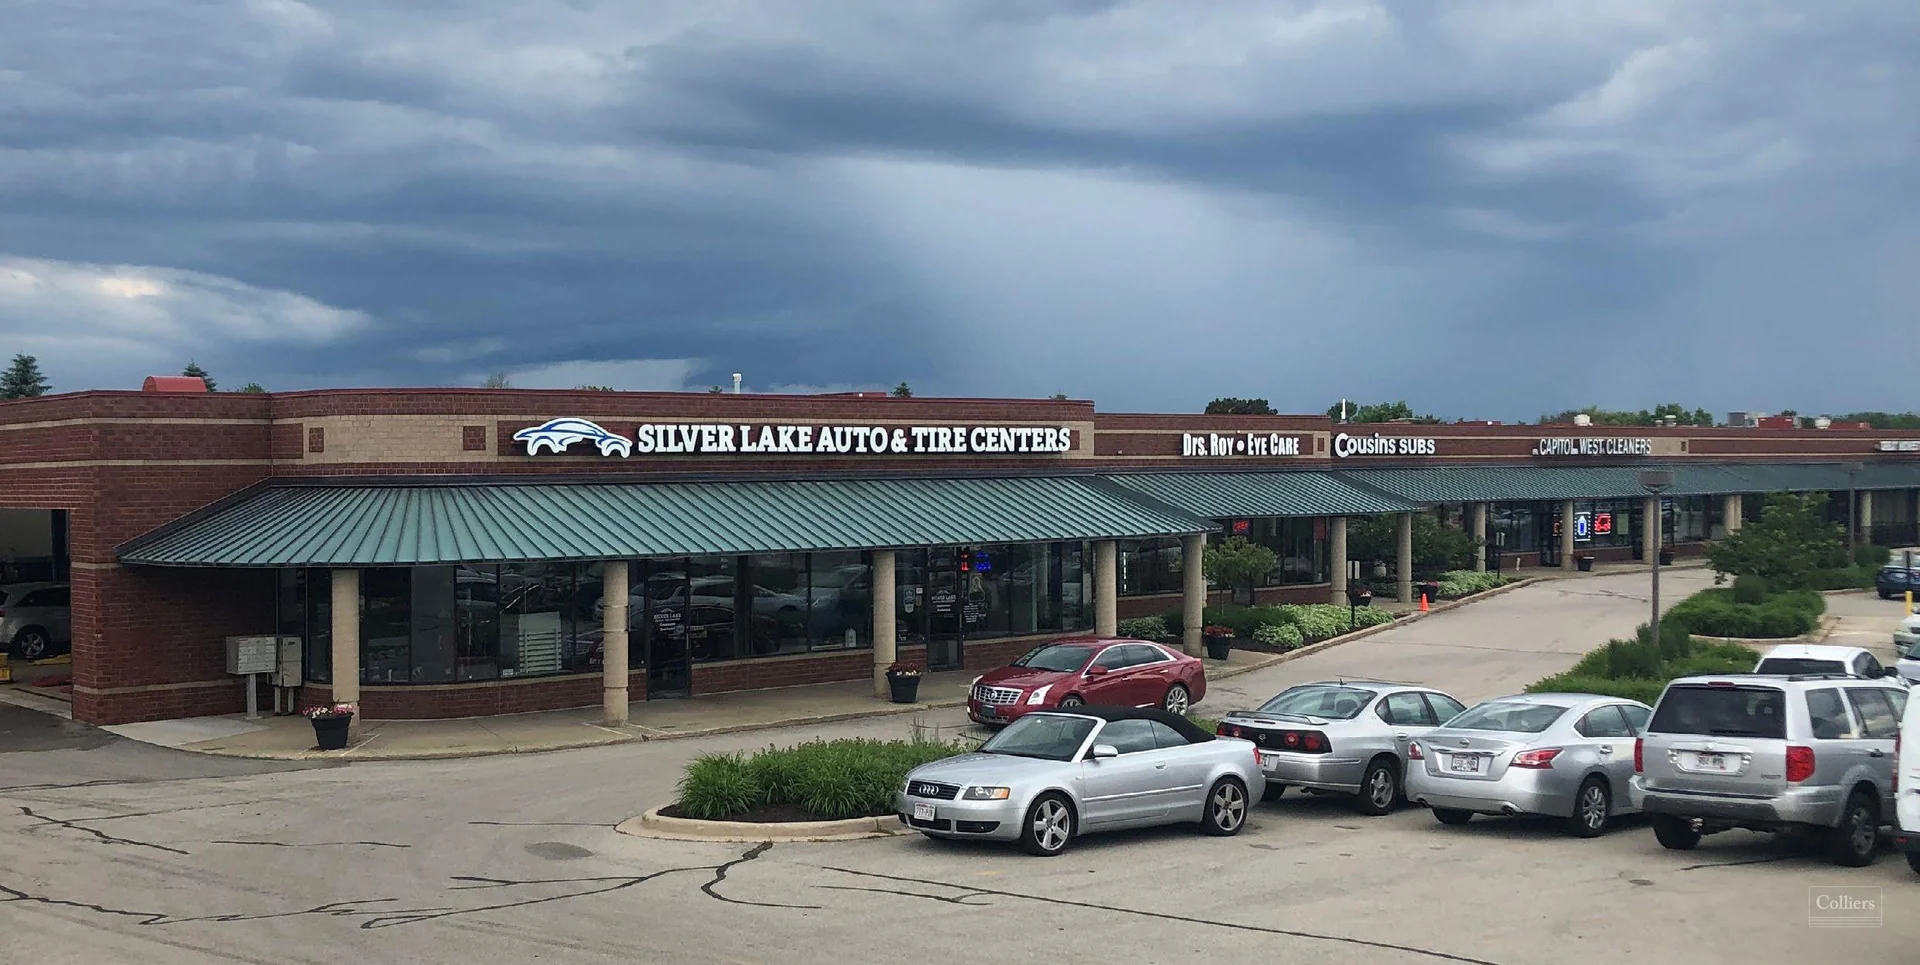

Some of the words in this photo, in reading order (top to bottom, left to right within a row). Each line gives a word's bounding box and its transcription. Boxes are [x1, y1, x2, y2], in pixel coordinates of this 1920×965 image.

[638, 424, 736, 453] SILVER
[740, 425, 813, 453] LAKE
[816, 426, 888, 453] AUTO
[890, 428, 908, 453] &
[911, 427, 967, 453] TIRE
[970, 427, 1071, 453] CENTERS
[1210, 433, 1234, 456] ROY
[1247, 433, 1268, 455] EYE
[1270, 433, 1299, 455] CARE
[1334, 432, 1396, 458] Cousins
[1540, 438, 1579, 455] CAPITOL
[1580, 438, 1604, 454] WEST
[1606, 438, 1652, 455] CLEANERS
